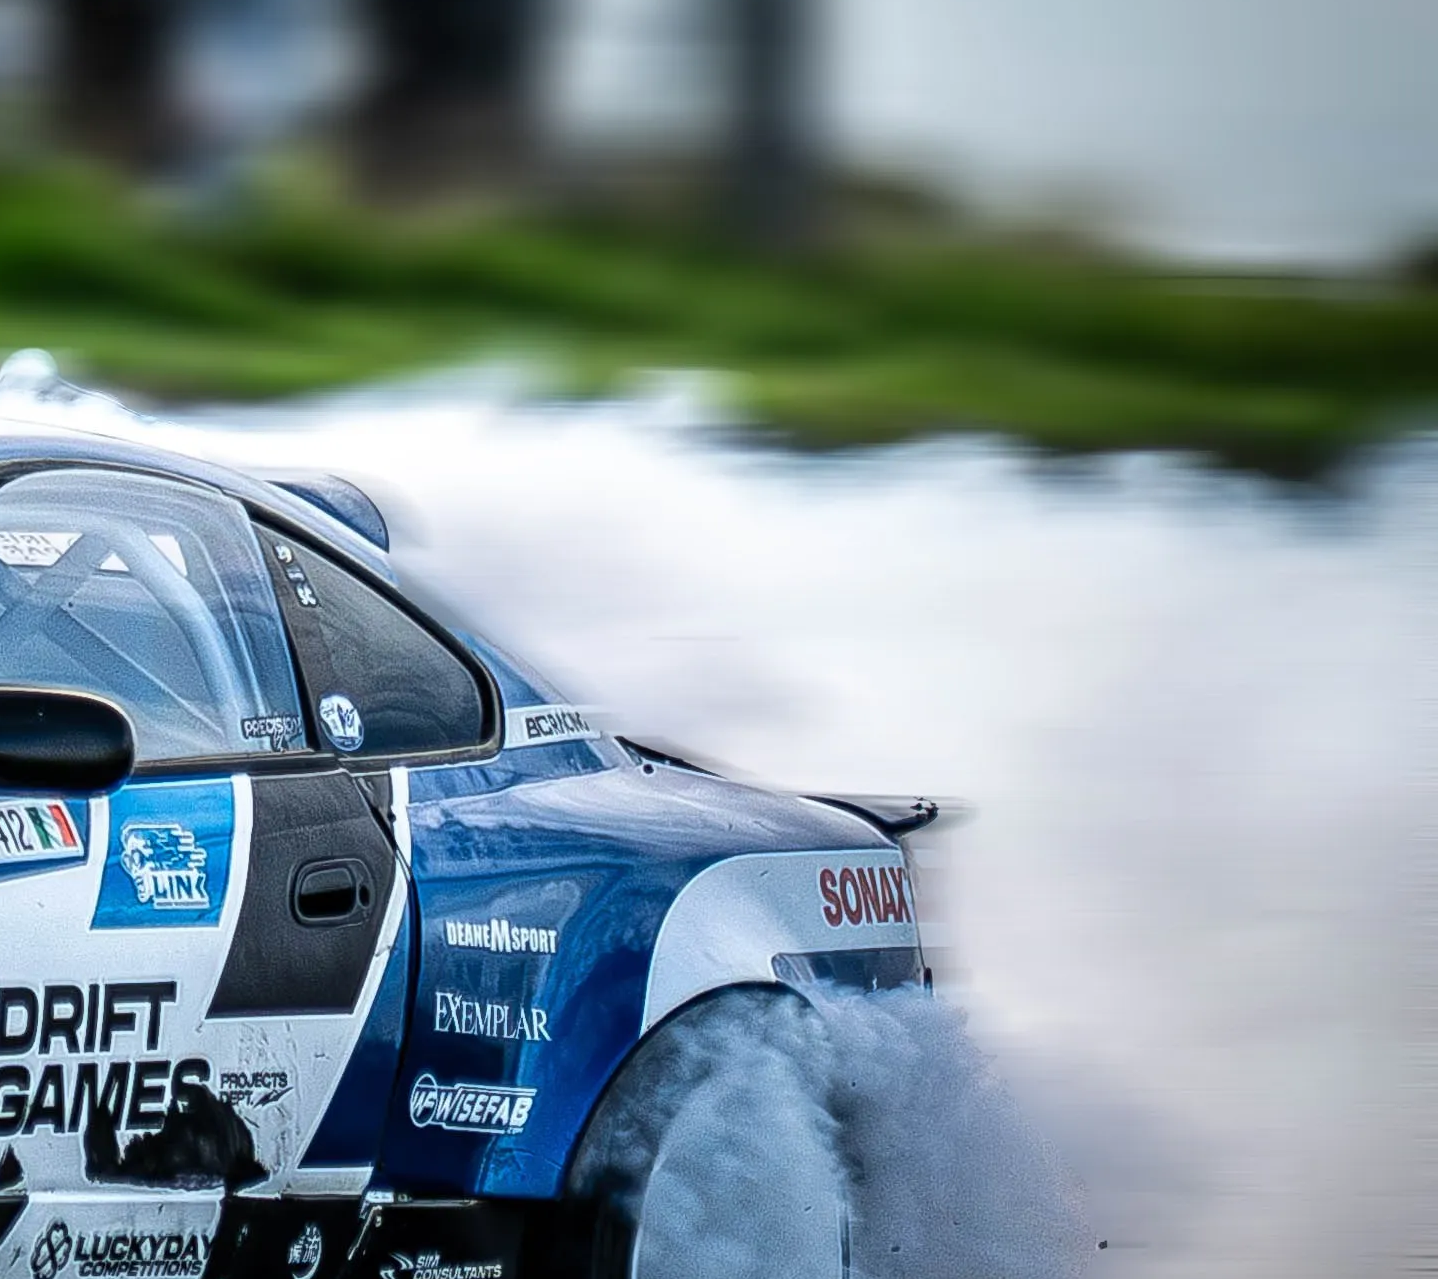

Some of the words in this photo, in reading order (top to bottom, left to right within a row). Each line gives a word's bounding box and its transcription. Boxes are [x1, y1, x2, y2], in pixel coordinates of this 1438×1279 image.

[152, 875, 206, 899] LINK
[820, 867, 912, 927] SONAX
[434, 990, 552, 1042] EXEMPLAR
[220, 1072, 288, 1089] PROJECTS
[436, 1088, 533, 1127] WISEFAB
[74, 1233, 213, 1261] LUCKYDAY
[79, 1260, 202, 1277] COMPETITIONS
